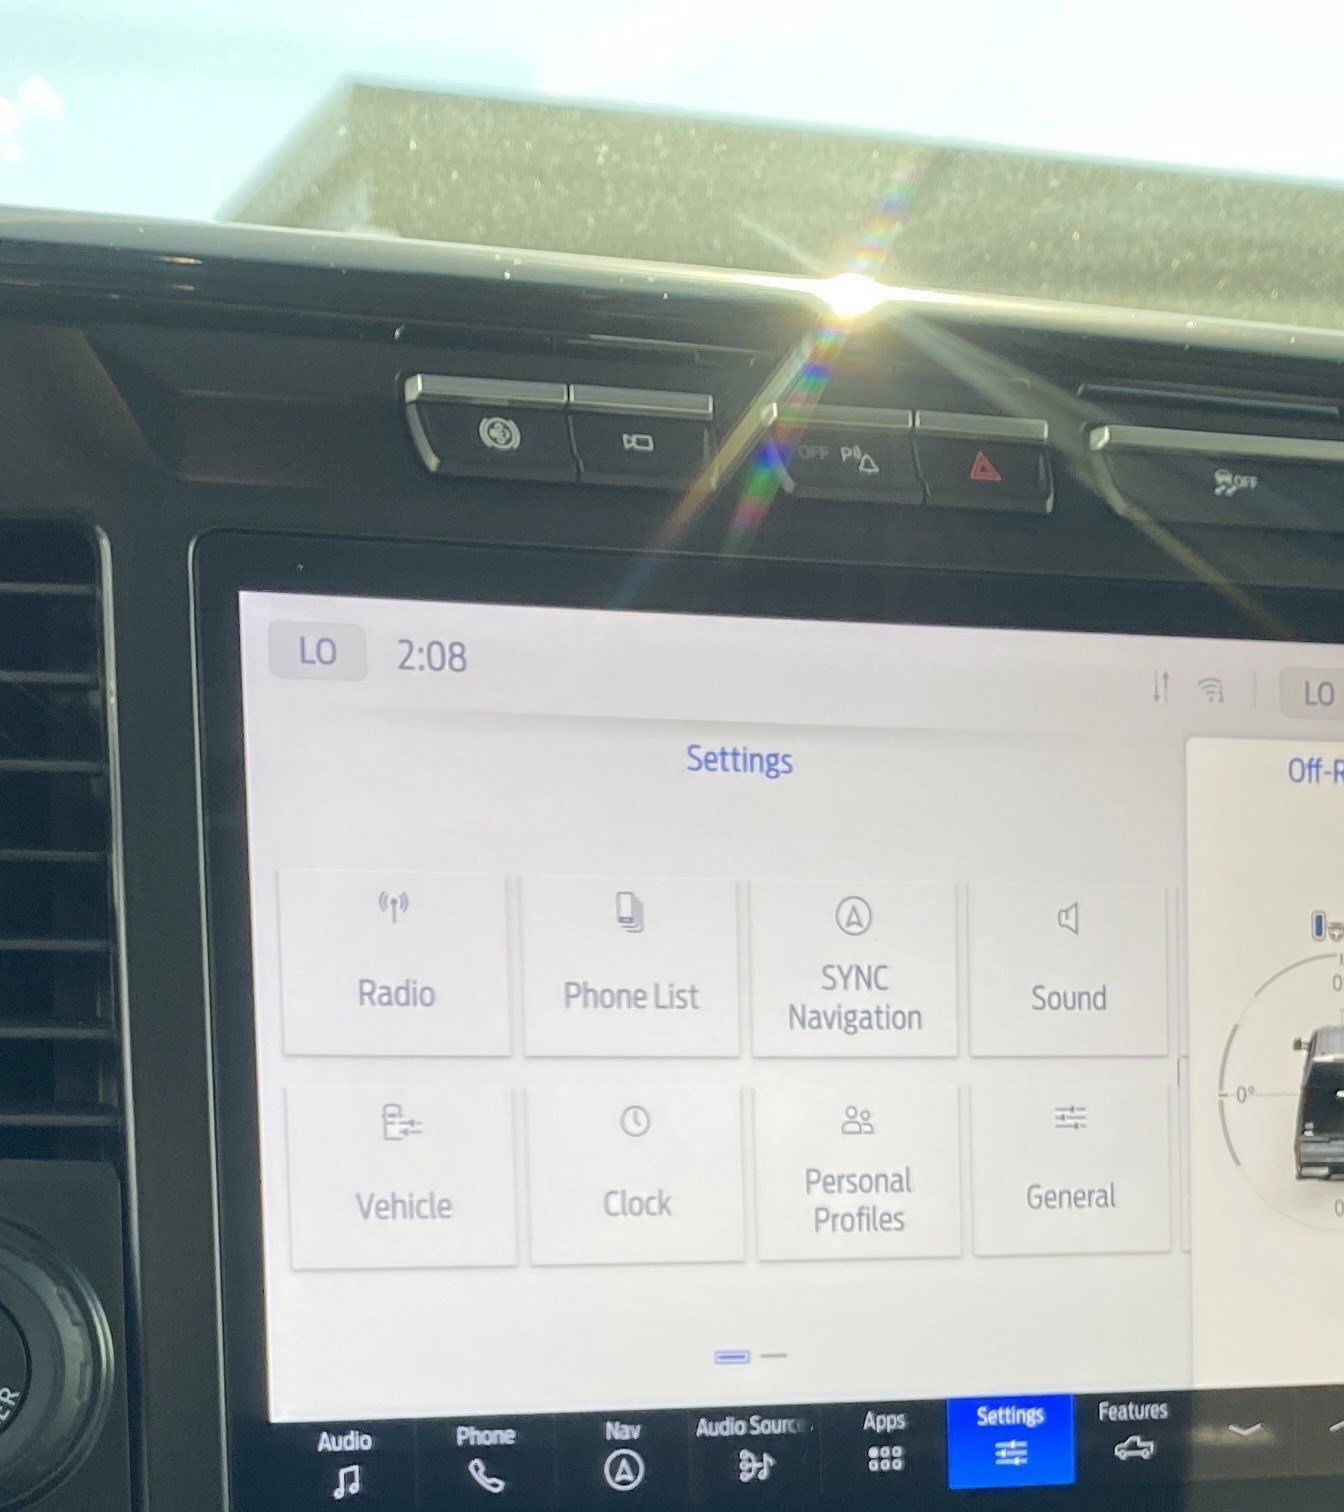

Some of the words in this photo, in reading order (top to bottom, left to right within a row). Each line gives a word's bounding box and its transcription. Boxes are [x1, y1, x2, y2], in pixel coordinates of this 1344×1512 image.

[299, 636, 337, 666] LO
[397, 639, 468, 673] 2:08
[1304, 680, 1335, 707] LO
[686, 743, 794, 780] Settings
[821, 964, 889, 991] SYNC
[357, 978, 436, 1007] Radio
[563, 981, 648, 1010] Phone
[654, 982, 700, 1011] List
[1031, 984, 1107, 1011] Sound
[788, 1002, 923, 1036] Navigation
[805, 1166, 912, 1195] Personal
[355, 1191, 453, 1221] Vehicle
[603, 1189, 673, 1217] Clock
[1026, 1182, 1117, 1209] General
[814, 1205, 906, 1233] Profiles
[863, 1410, 906, 1433] Apps
[976, 1404, 1045, 1430] Settings
[1099, 1399, 1169, 1422] Features
[456, 1425, 516, 1447] Phone
[605, 1421, 641, 1442] Nav
[695, 1415, 747, 1437] Audio
[317, 1431, 373, 1453] Audio
